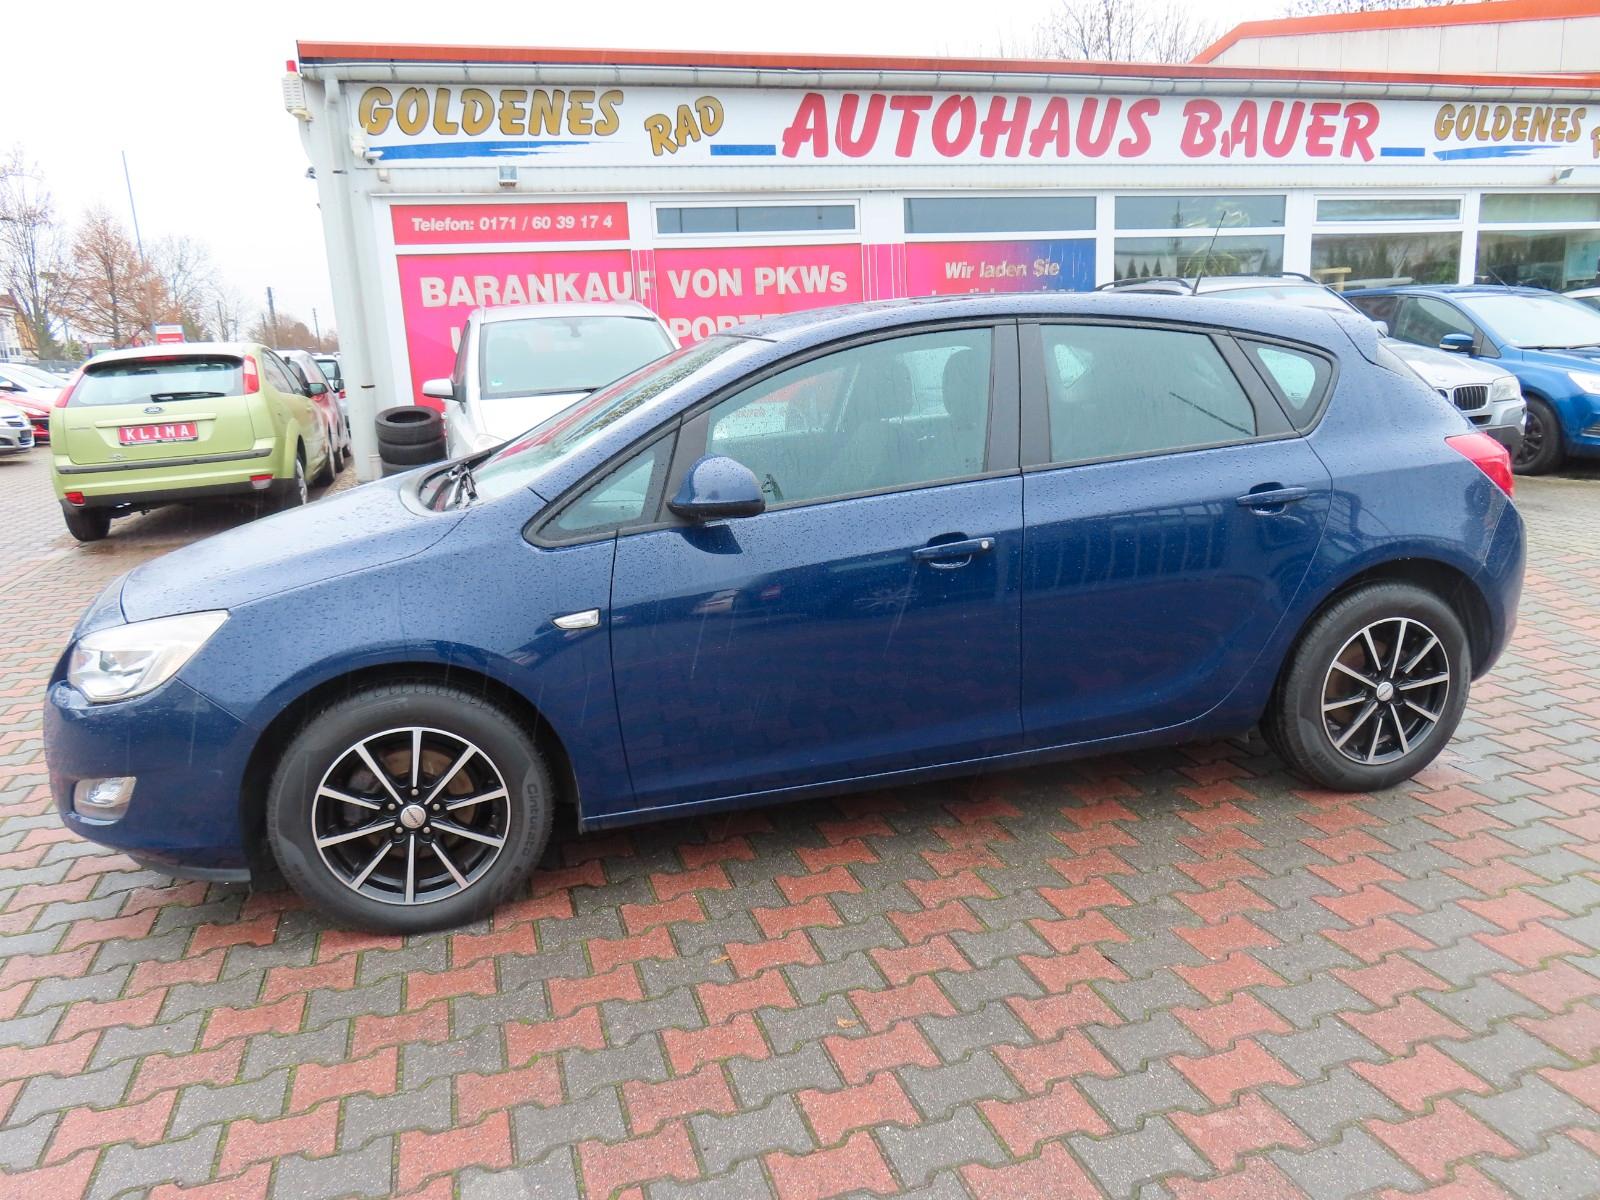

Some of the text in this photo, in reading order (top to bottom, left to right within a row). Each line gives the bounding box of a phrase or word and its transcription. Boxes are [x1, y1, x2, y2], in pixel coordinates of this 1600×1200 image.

[357, 86, 724, 157] GOLDENES RAD
[782, 92, 1381, 162] AUTOHAUS BAUER
[1434, 103, 1587, 143] GOLDENES
[411, 217, 474, 232] Telefon:
[479, 217, 516, 231] 0171
[521, 216, 528, 231] /
[532, 216, 550, 230] 60
[556, 216, 575, 229] 39
[419, 264, 848, 308] BARANKAUF VON PKWs
[945, 256, 1060, 279] Wir laden Sie
[125, 424, 190, 441] KLIMA
